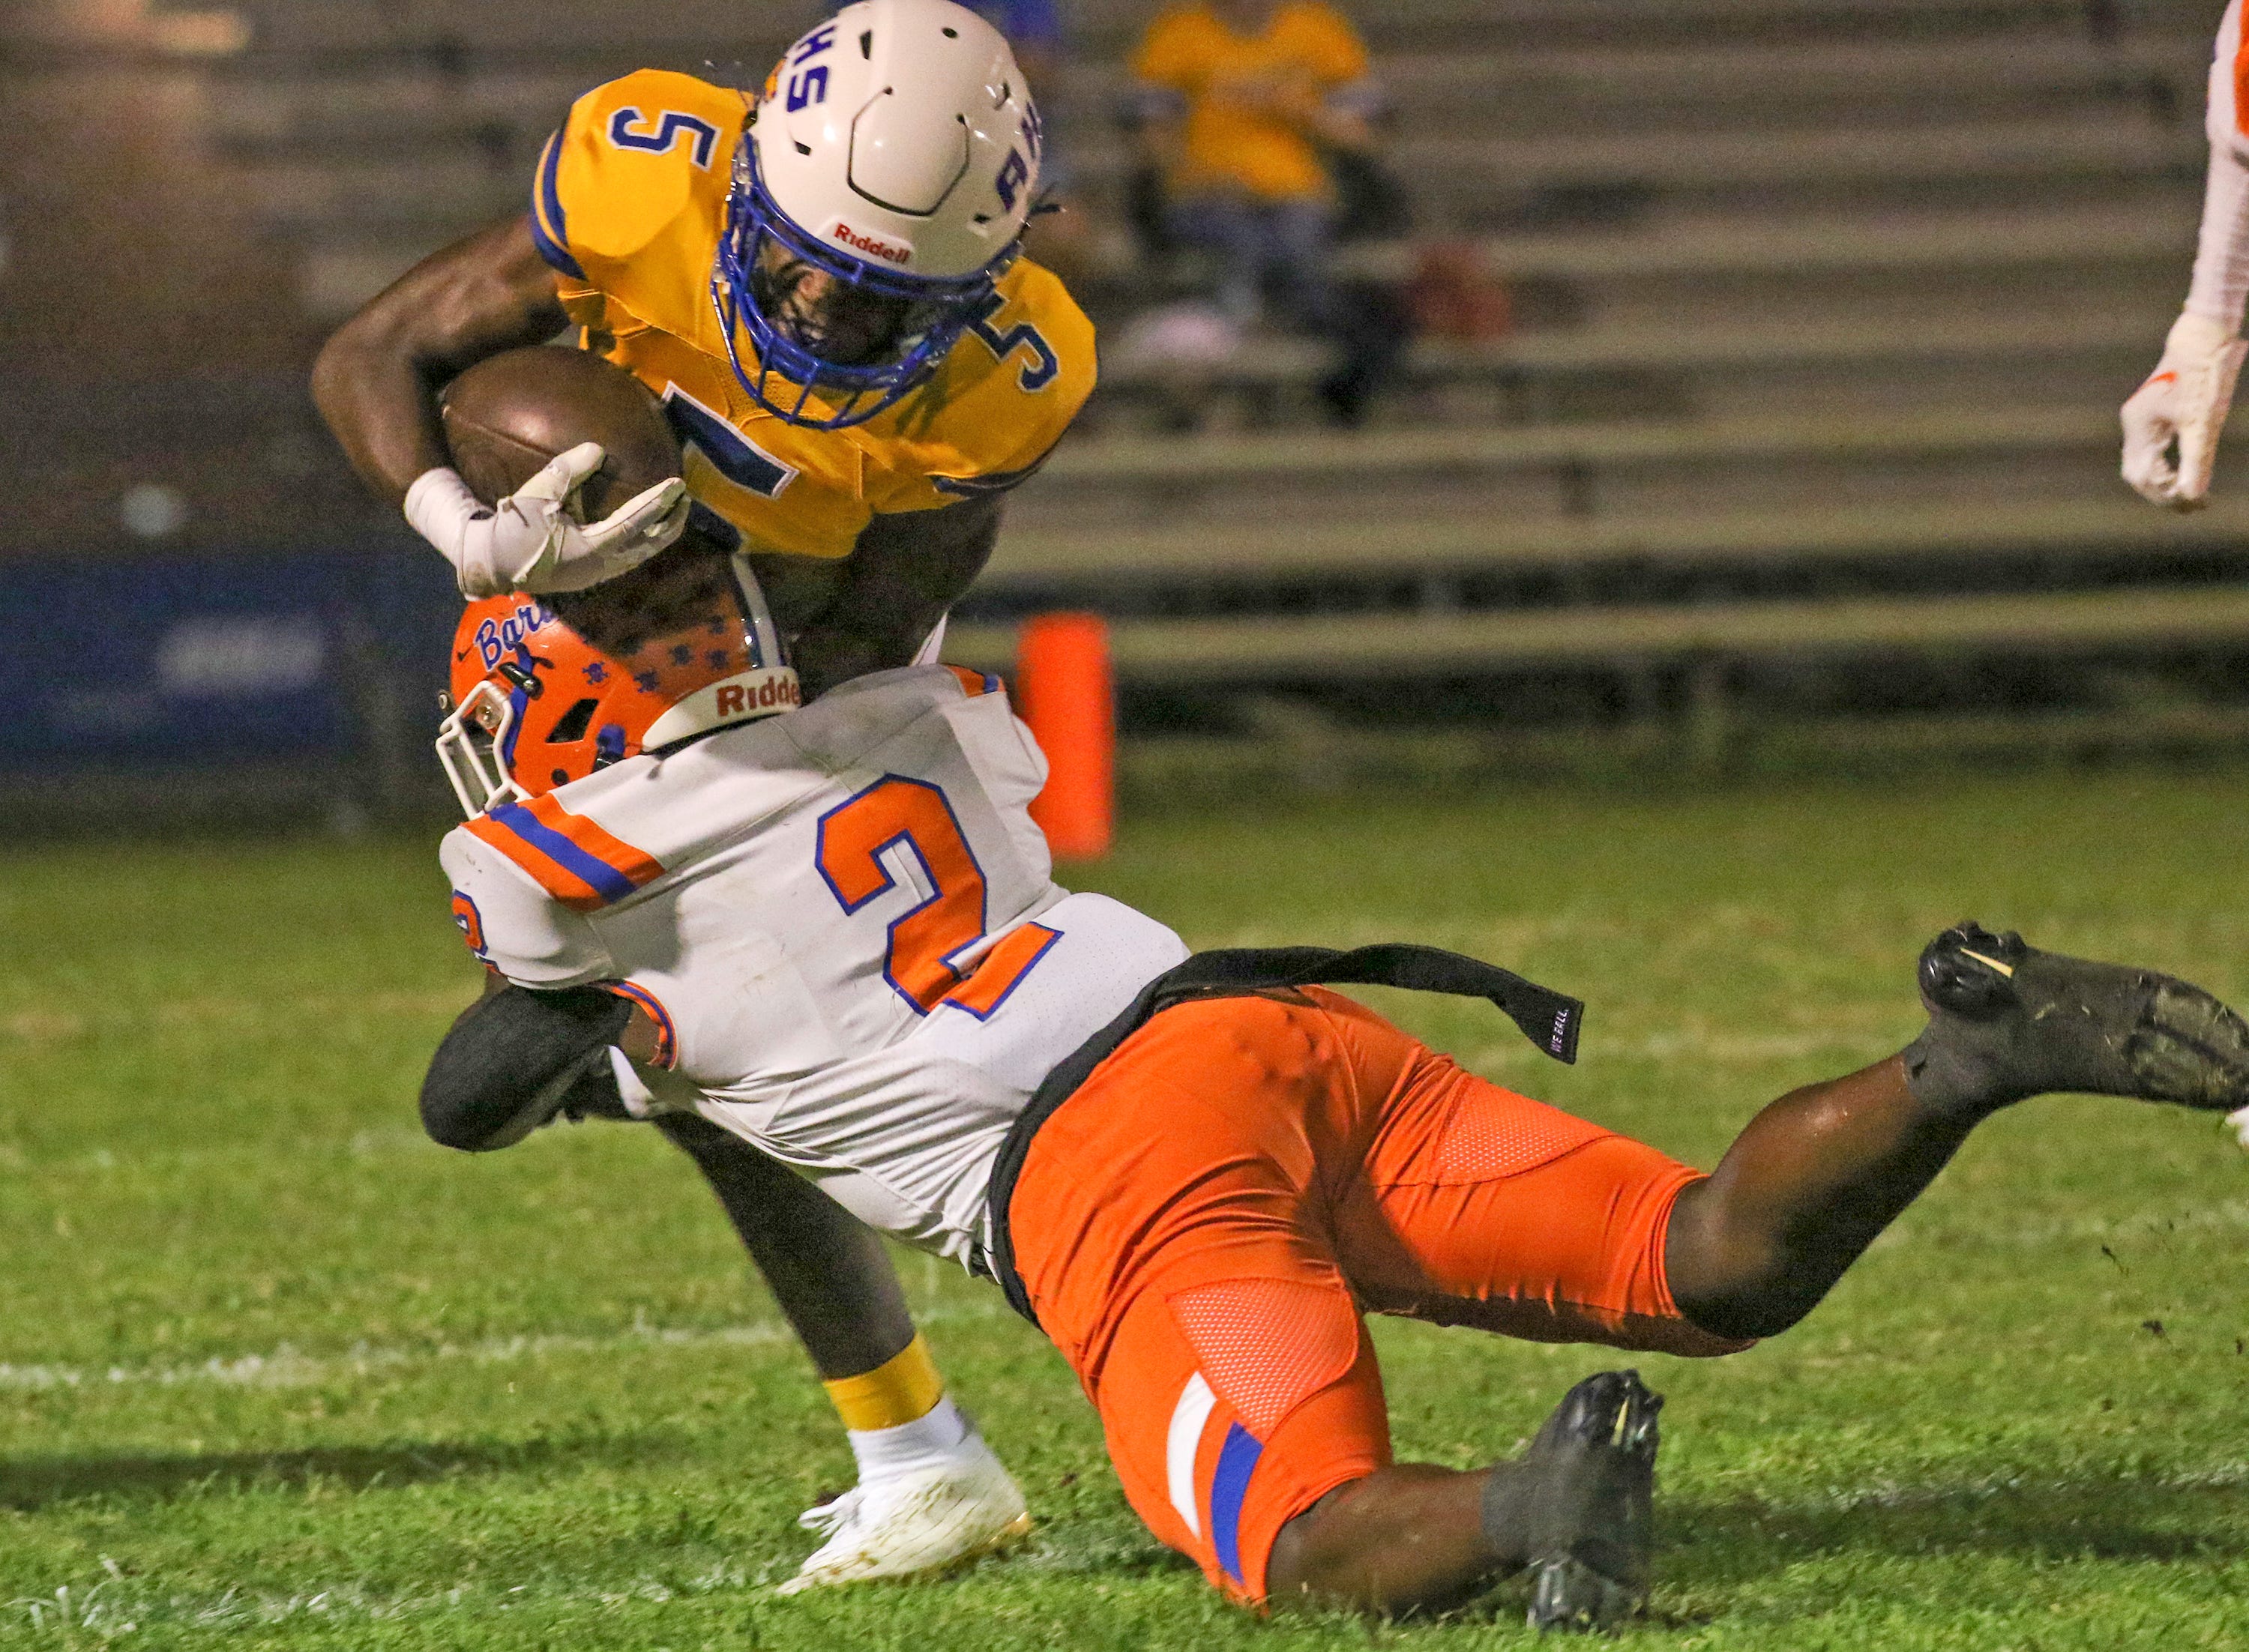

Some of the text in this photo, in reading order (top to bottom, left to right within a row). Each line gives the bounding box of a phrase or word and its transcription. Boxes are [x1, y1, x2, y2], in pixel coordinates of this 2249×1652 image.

[606, 105, 722, 172] 5
[834, 222, 911, 265] Riddell
[964, 289, 1062, 394] 5
[814, 772, 1065, 1022] 2
[1550, 1034, 1562, 1053] WE
